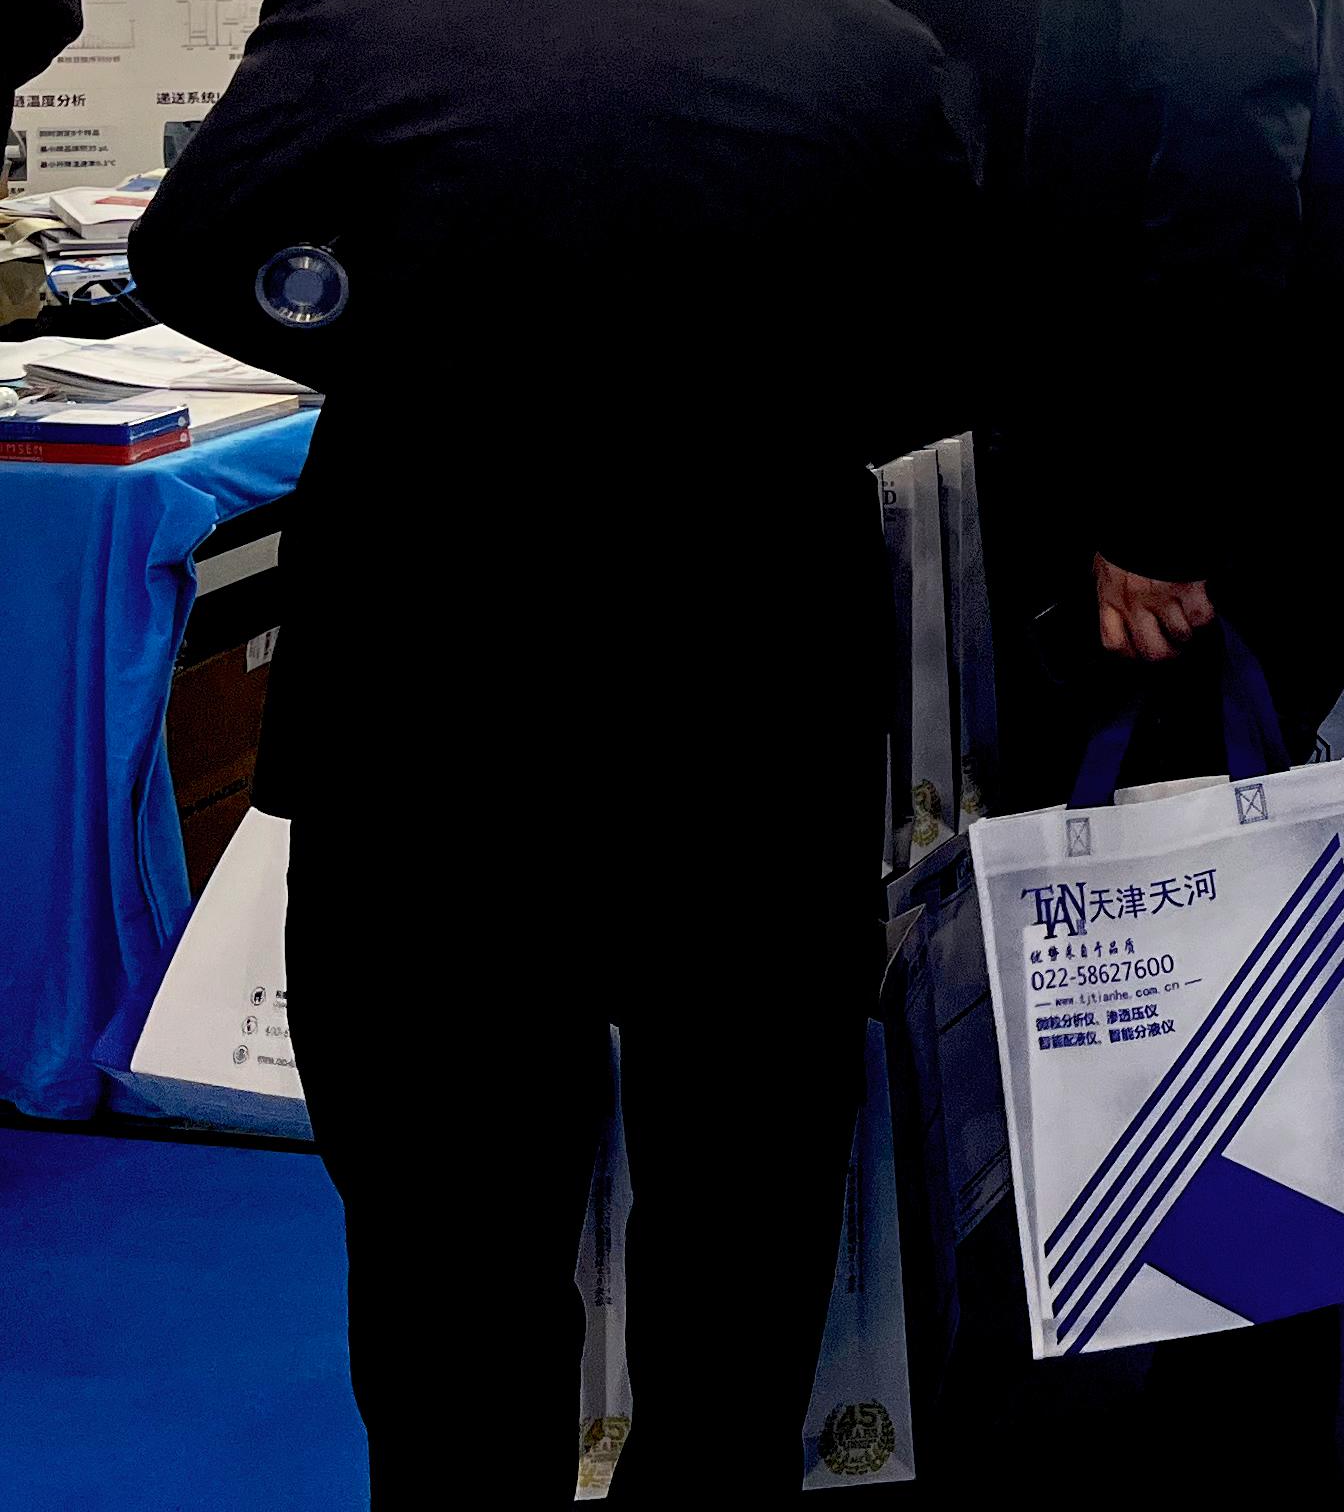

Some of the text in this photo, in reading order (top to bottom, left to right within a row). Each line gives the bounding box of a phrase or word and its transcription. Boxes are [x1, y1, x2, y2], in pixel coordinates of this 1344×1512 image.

[156, 91, 219, 105] 递送系统
[1089, 869, 1217, 923] 天津天河
[1031, 954, 1174, 991] 022-58627600
